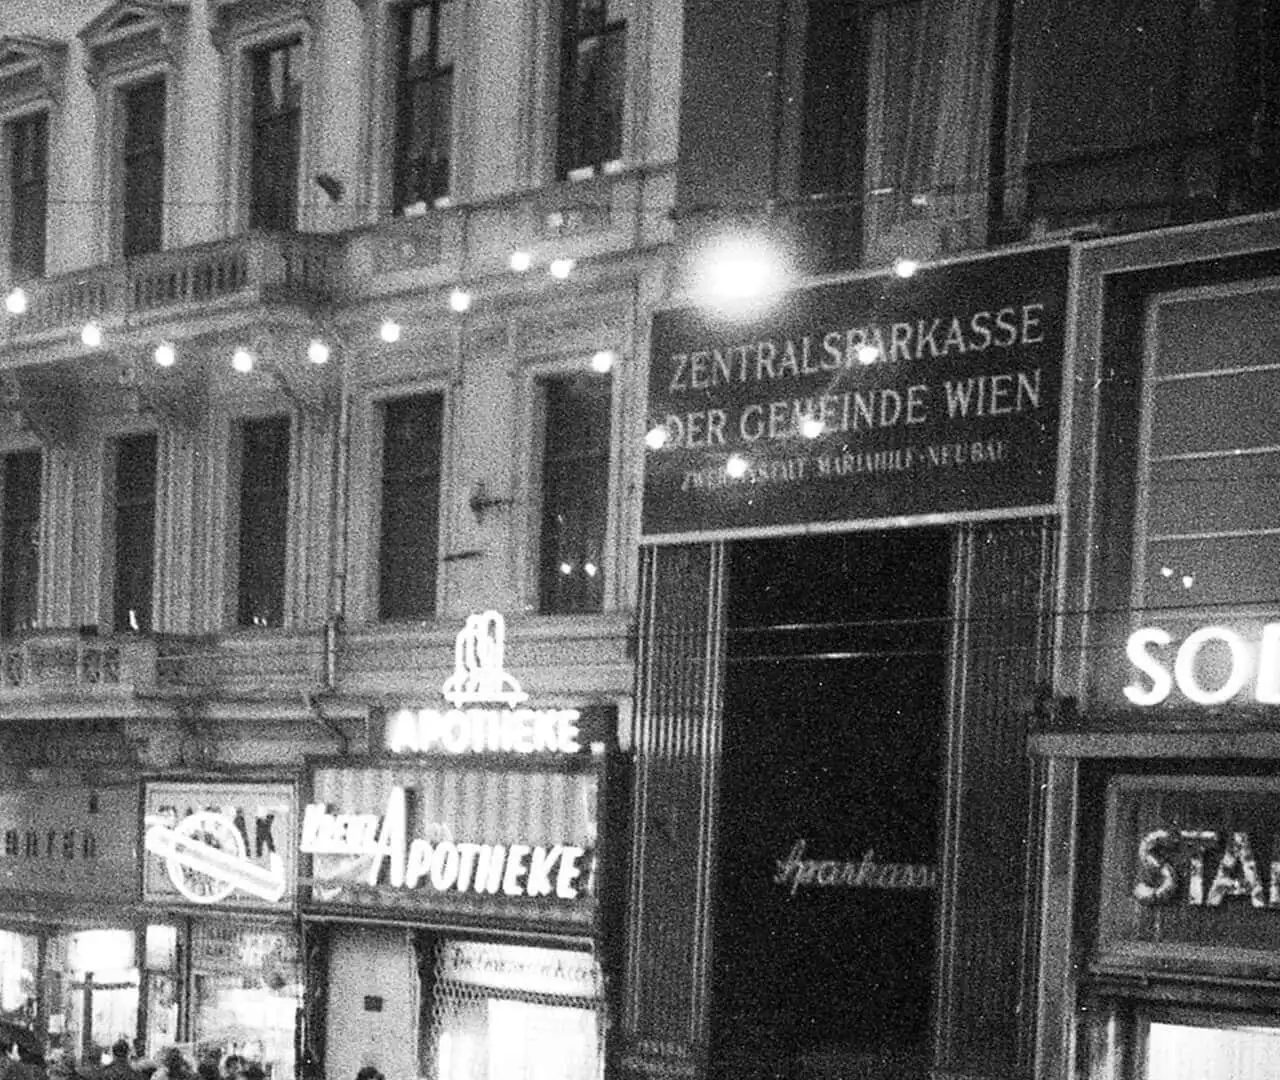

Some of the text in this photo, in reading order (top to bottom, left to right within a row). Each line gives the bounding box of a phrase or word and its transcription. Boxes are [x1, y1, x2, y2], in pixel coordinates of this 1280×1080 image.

[670, 303, 1044, 394] ZENTRALSPARKASSE
[666, 371, 1042, 452] DER GEMEINDE WIEN
[1122, 622, 1280, 706] SO
[387, 707, 581, 754] APOTHEKE
[368, 784, 585, 900] APOTHEKE
[1134, 829, 1280, 908] STA
